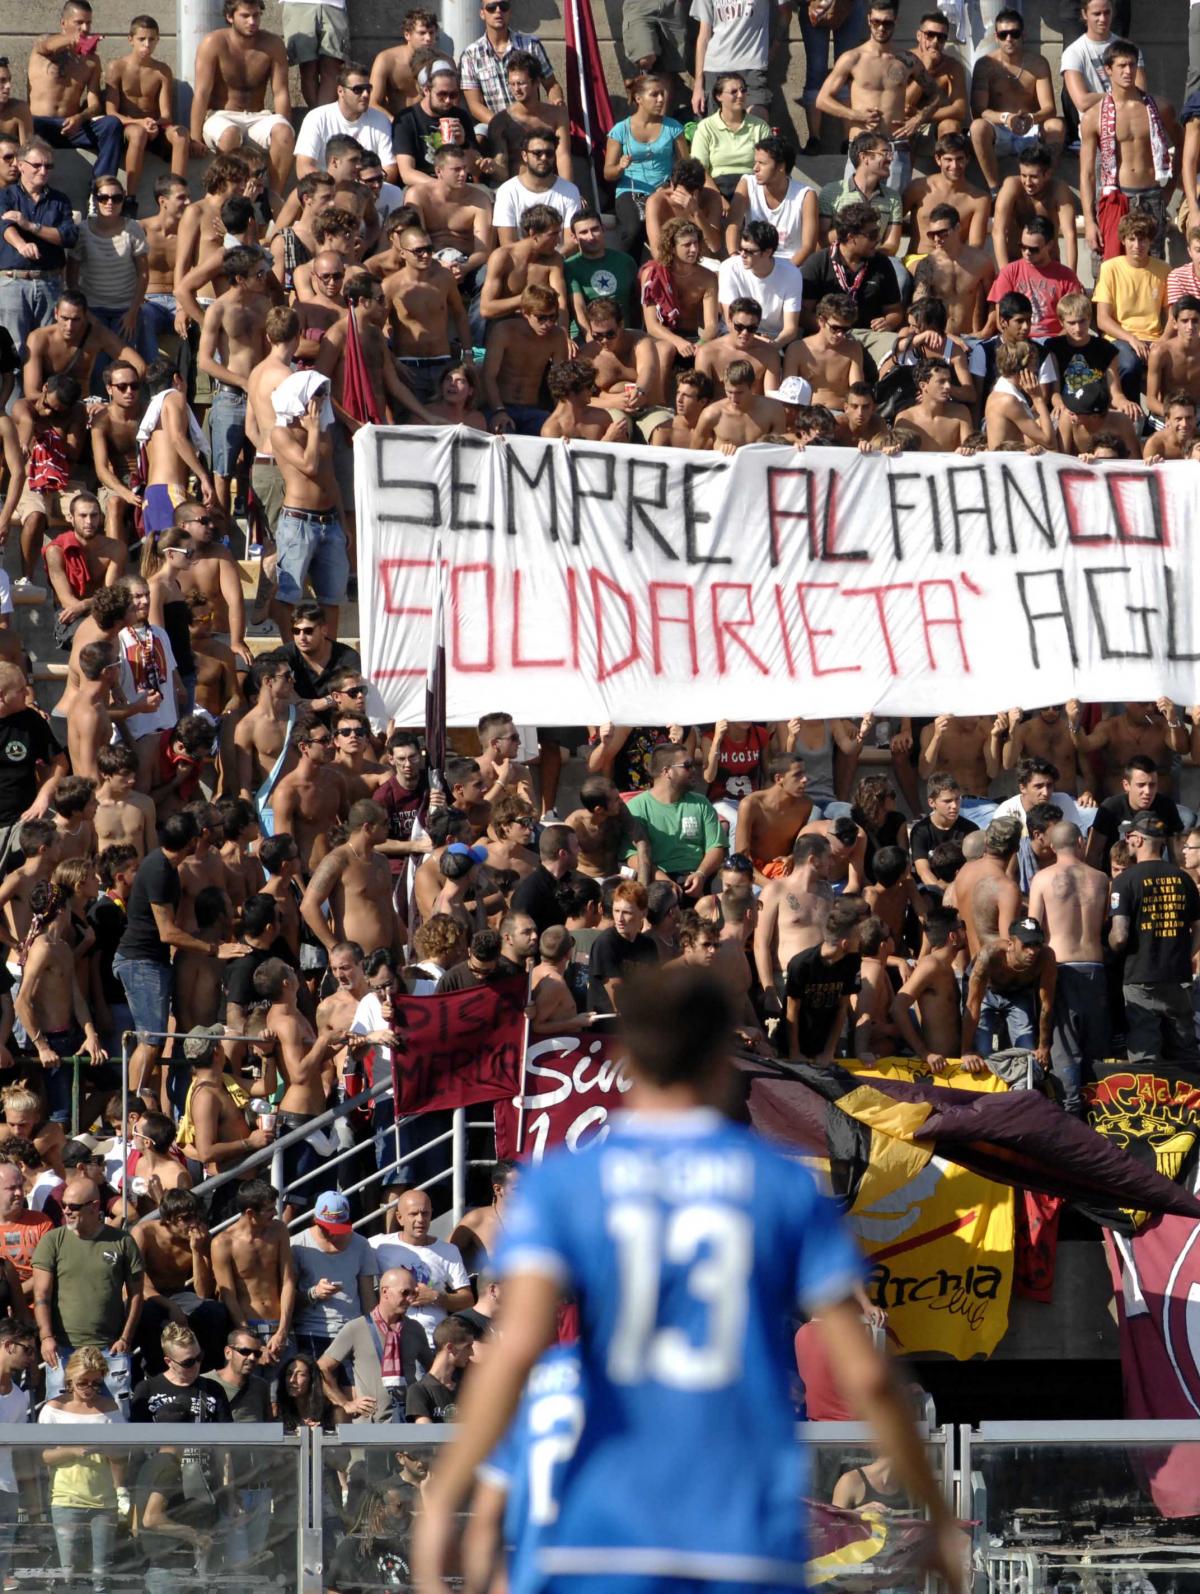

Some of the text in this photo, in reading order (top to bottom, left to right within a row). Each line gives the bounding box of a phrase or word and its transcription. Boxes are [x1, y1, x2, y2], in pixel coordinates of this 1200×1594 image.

[377, 434, 732, 565] SEMPRE
[768, 465, 871, 568] AL
[889, 462, 1170, 561] FIANCO
[731, 749, 760, 763] GOSH
[606, 1201, 755, 1391] 13
